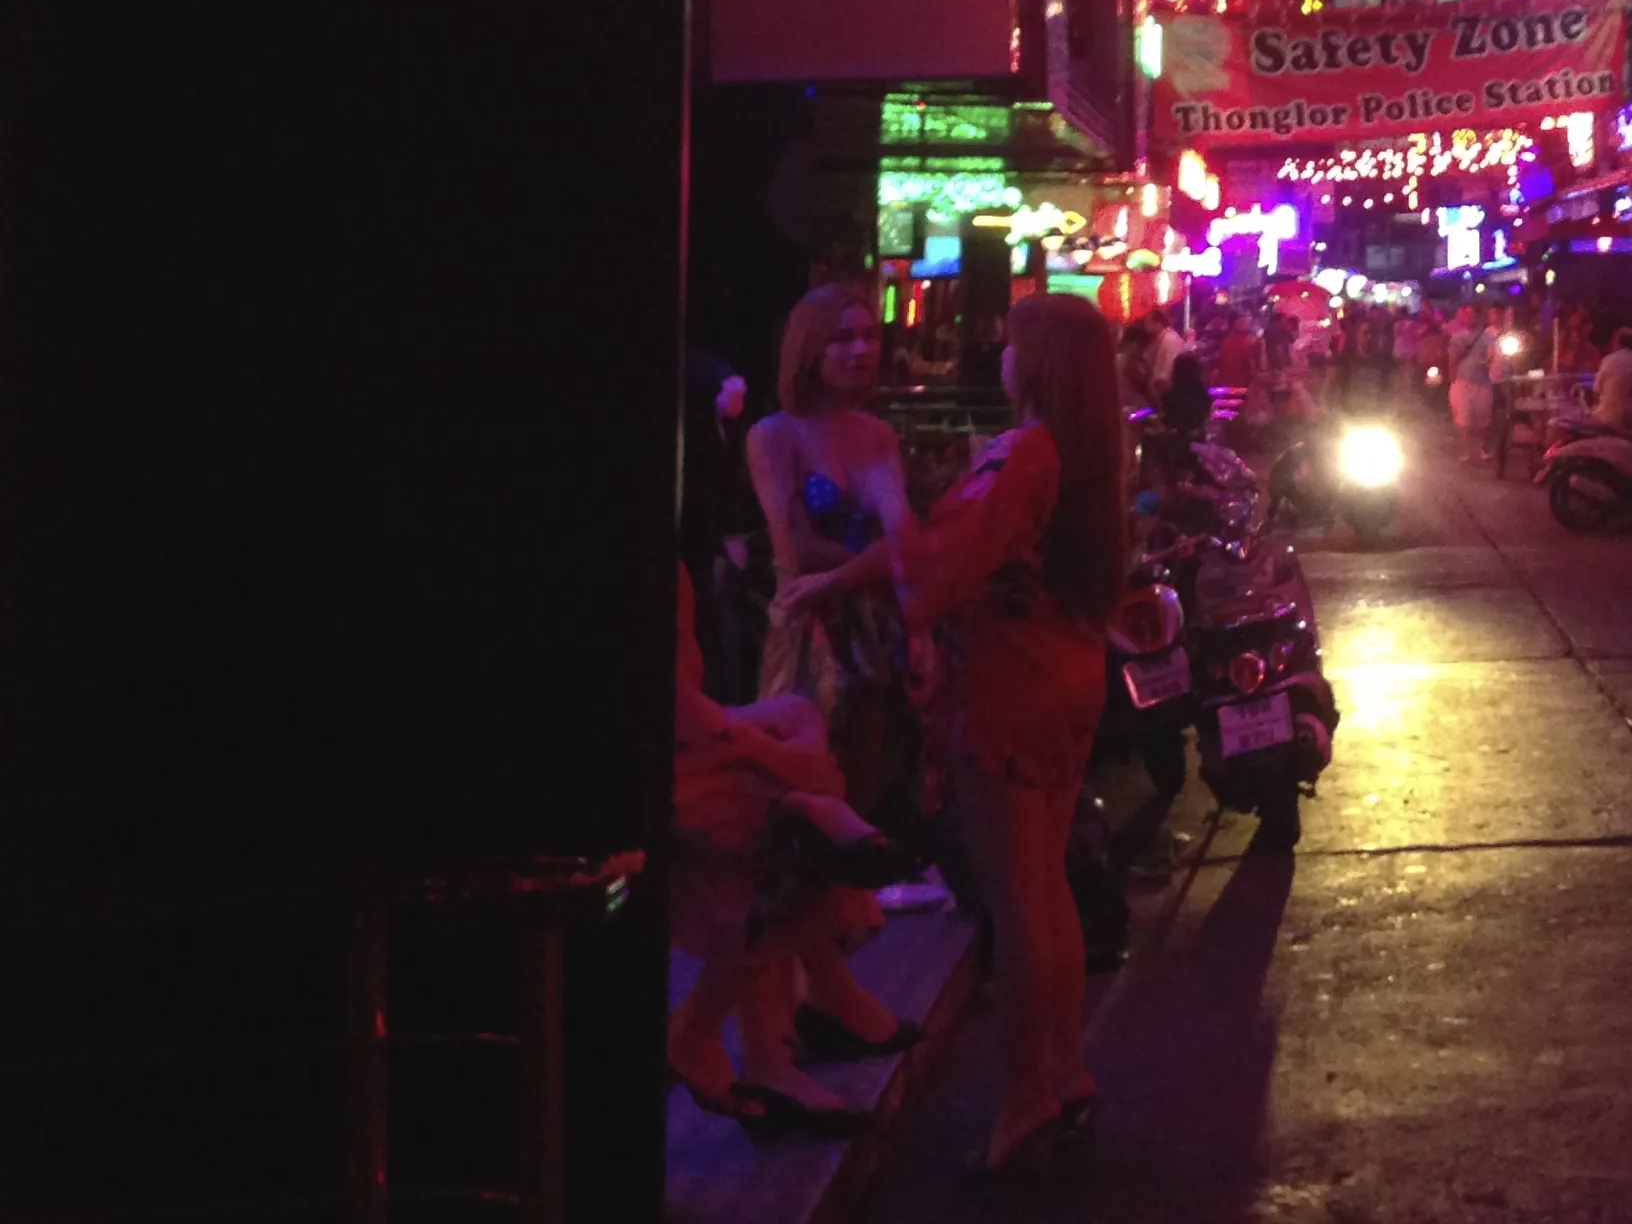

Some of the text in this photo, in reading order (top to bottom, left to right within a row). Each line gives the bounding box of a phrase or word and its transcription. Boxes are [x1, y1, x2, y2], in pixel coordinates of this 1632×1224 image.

[1251, 7, 1588, 76] Safety Zone
[1174, 70, 1618, 136] Thonglor Police Station
